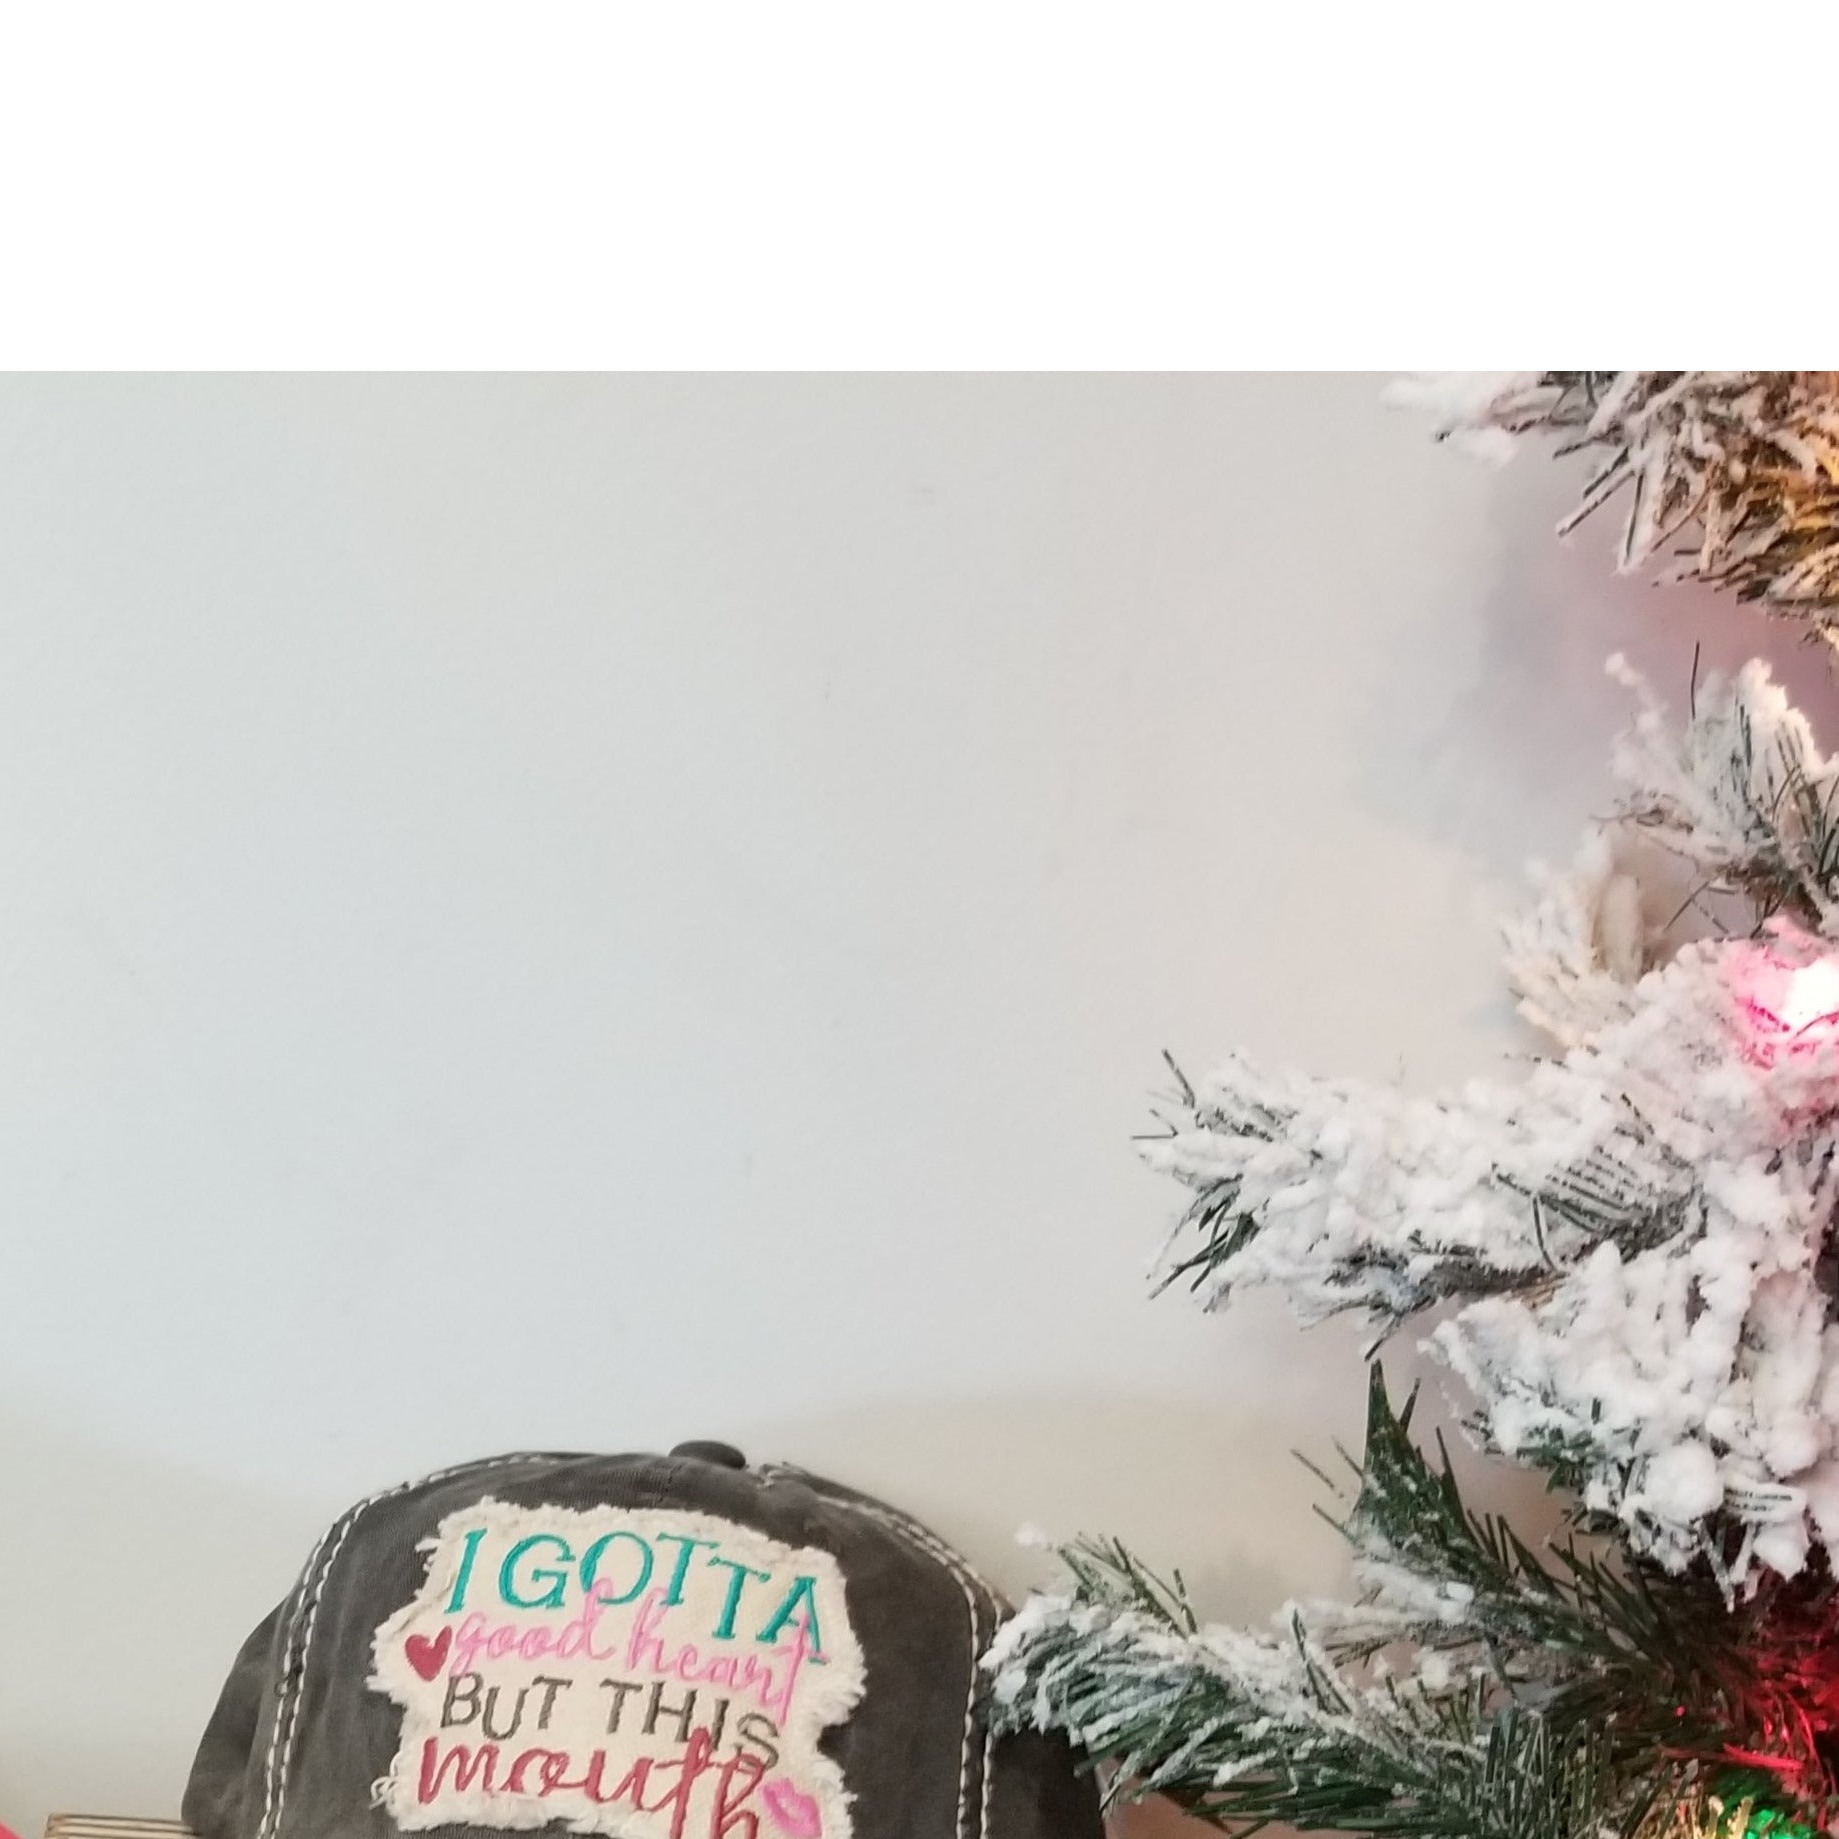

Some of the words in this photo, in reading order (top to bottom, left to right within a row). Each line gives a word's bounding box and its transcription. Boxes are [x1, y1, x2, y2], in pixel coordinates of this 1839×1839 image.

[444, 1528, 487, 1613] I
[499, 1531, 826, 1664] GOTTA
[451, 1578, 617, 1680] good
[625, 1587, 828, 1727] heart
[440, 1672, 573, 1741] BUT
[599, 1678, 779, 1772] THIS
